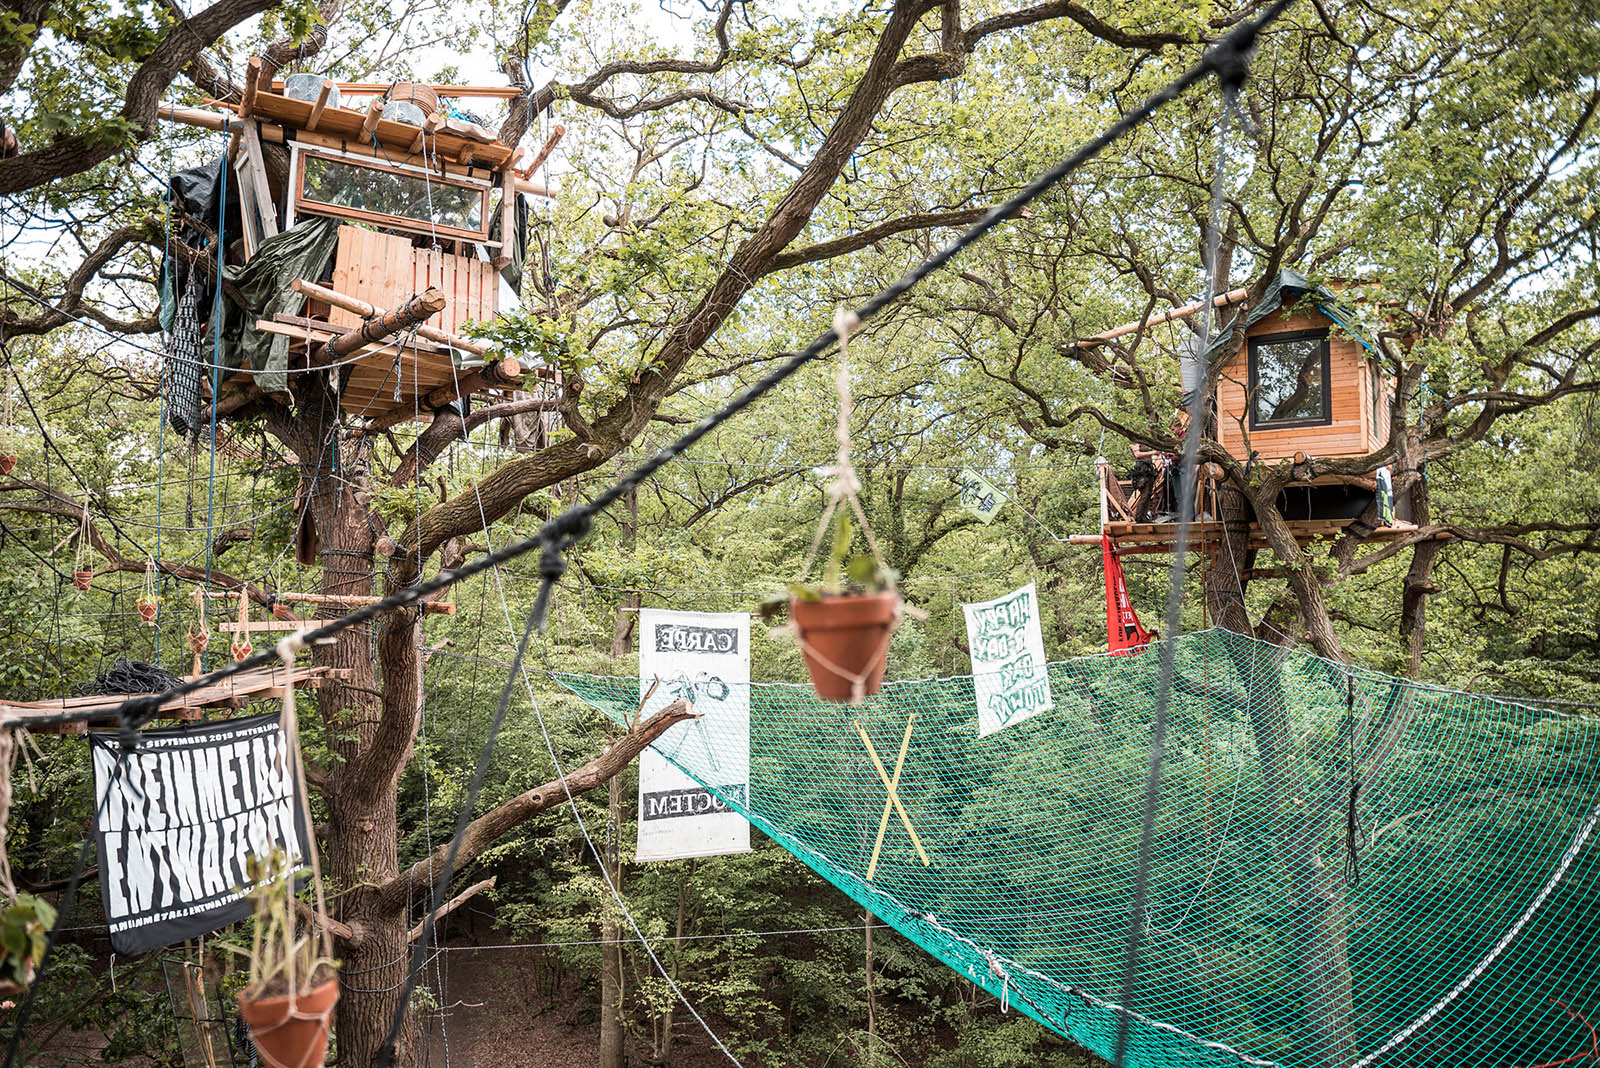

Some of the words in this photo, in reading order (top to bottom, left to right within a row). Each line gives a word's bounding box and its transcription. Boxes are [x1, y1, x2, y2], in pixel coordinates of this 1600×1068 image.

[146, 735, 208, 749] SEPTEMBER
[209, 731, 234, 742] 2019
[93, 730, 294, 832] RHEINMETALL
